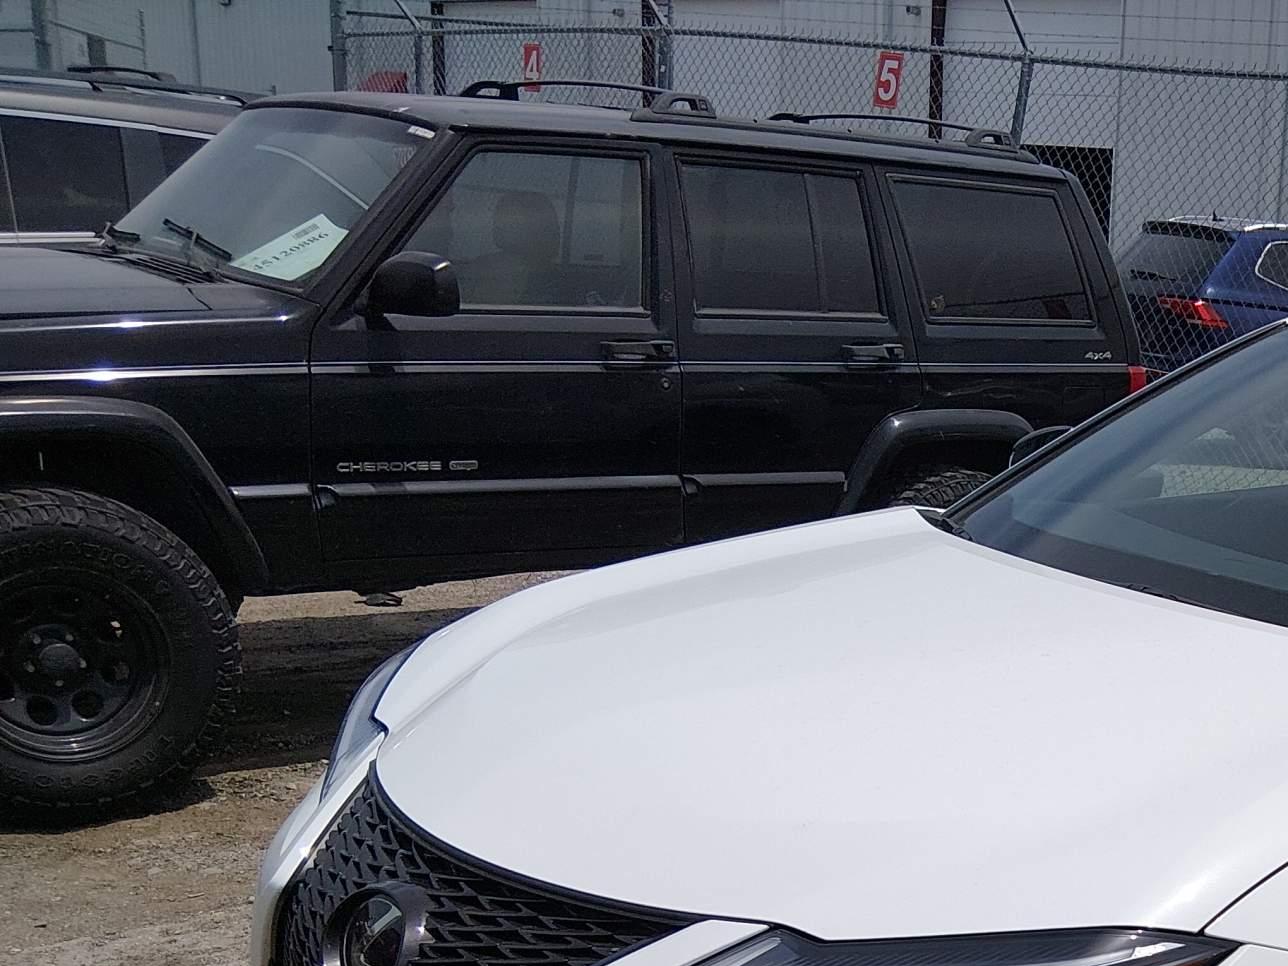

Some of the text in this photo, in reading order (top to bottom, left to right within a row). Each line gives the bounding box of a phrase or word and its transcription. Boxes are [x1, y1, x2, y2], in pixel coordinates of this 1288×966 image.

[525, 50, 539, 81] 4
[877, 59, 899, 101] 5
[336, 461, 442, 473] CHEROKEE
